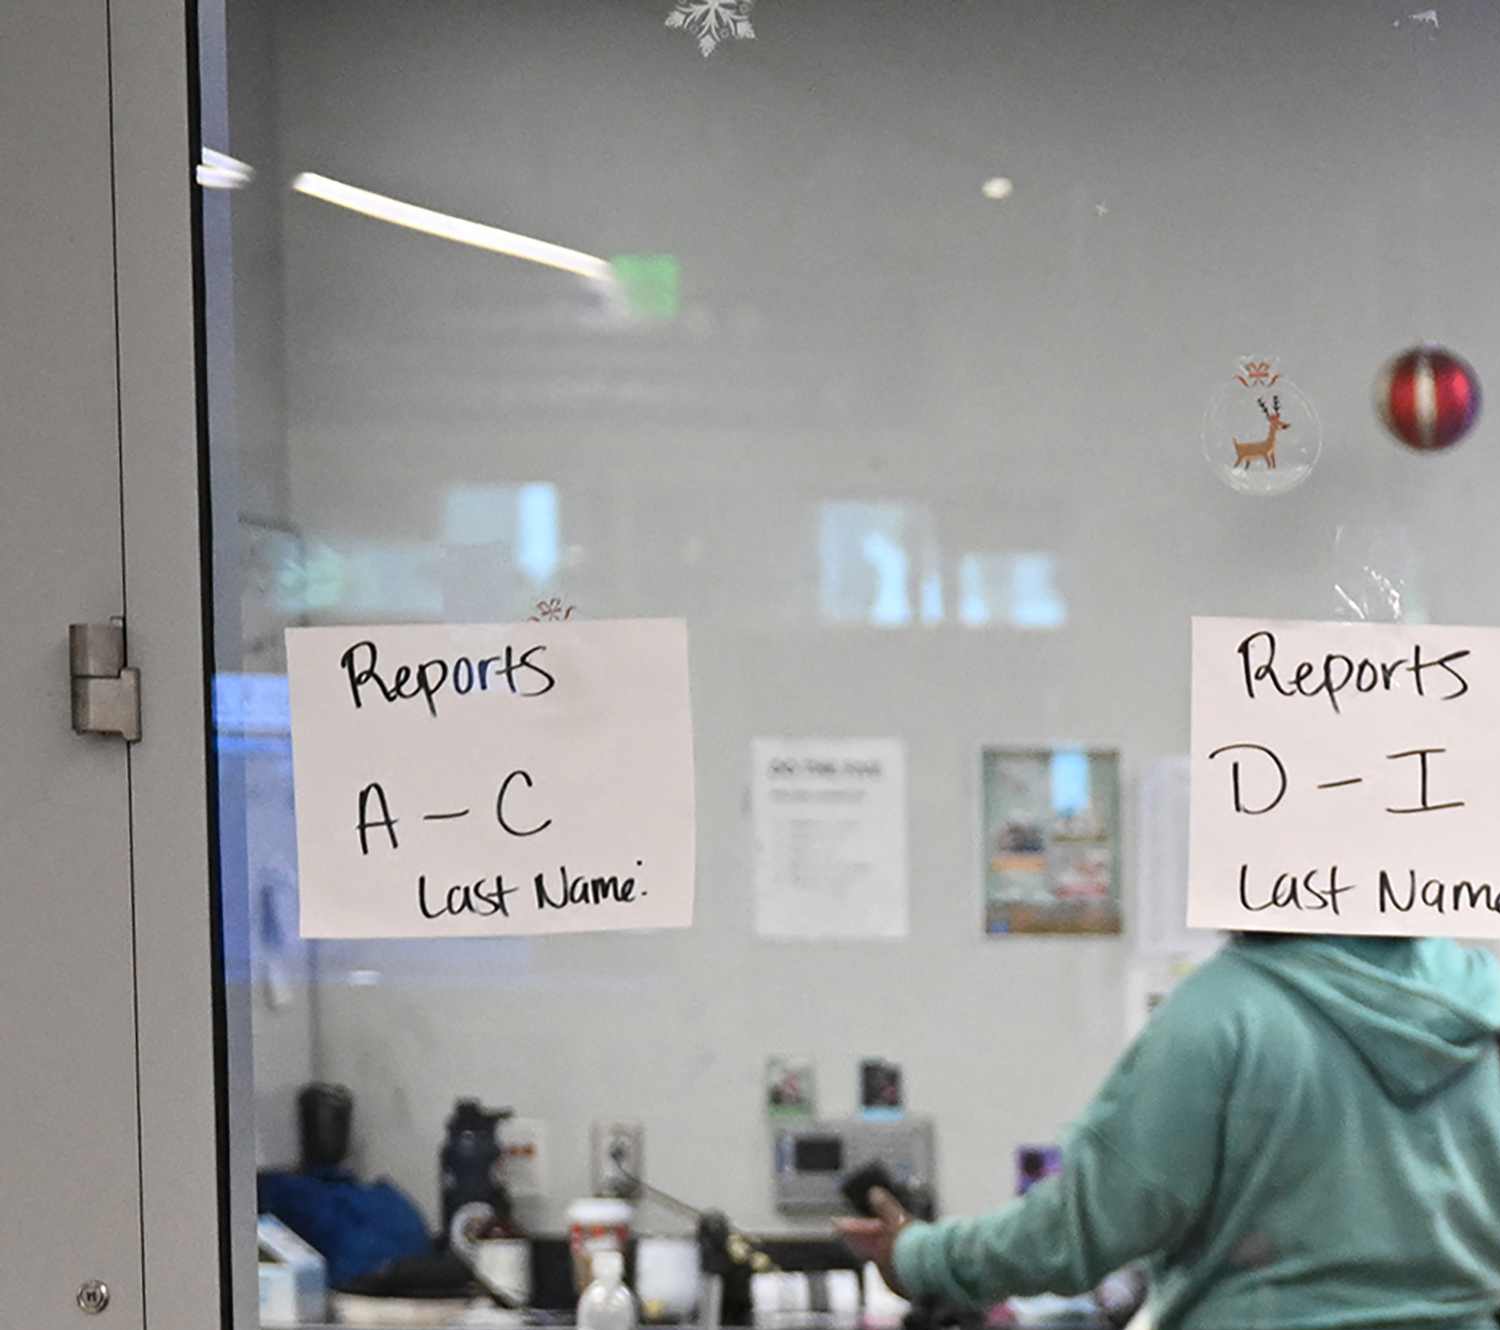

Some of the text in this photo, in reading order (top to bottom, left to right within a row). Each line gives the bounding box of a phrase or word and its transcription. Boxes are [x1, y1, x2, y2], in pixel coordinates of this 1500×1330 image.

[341, 640, 556, 717] Reports
[1237, 631, 1471, 714] Reports
[418, 873, 519, 919] Last
[1240, 865, 1357, 915] Last
